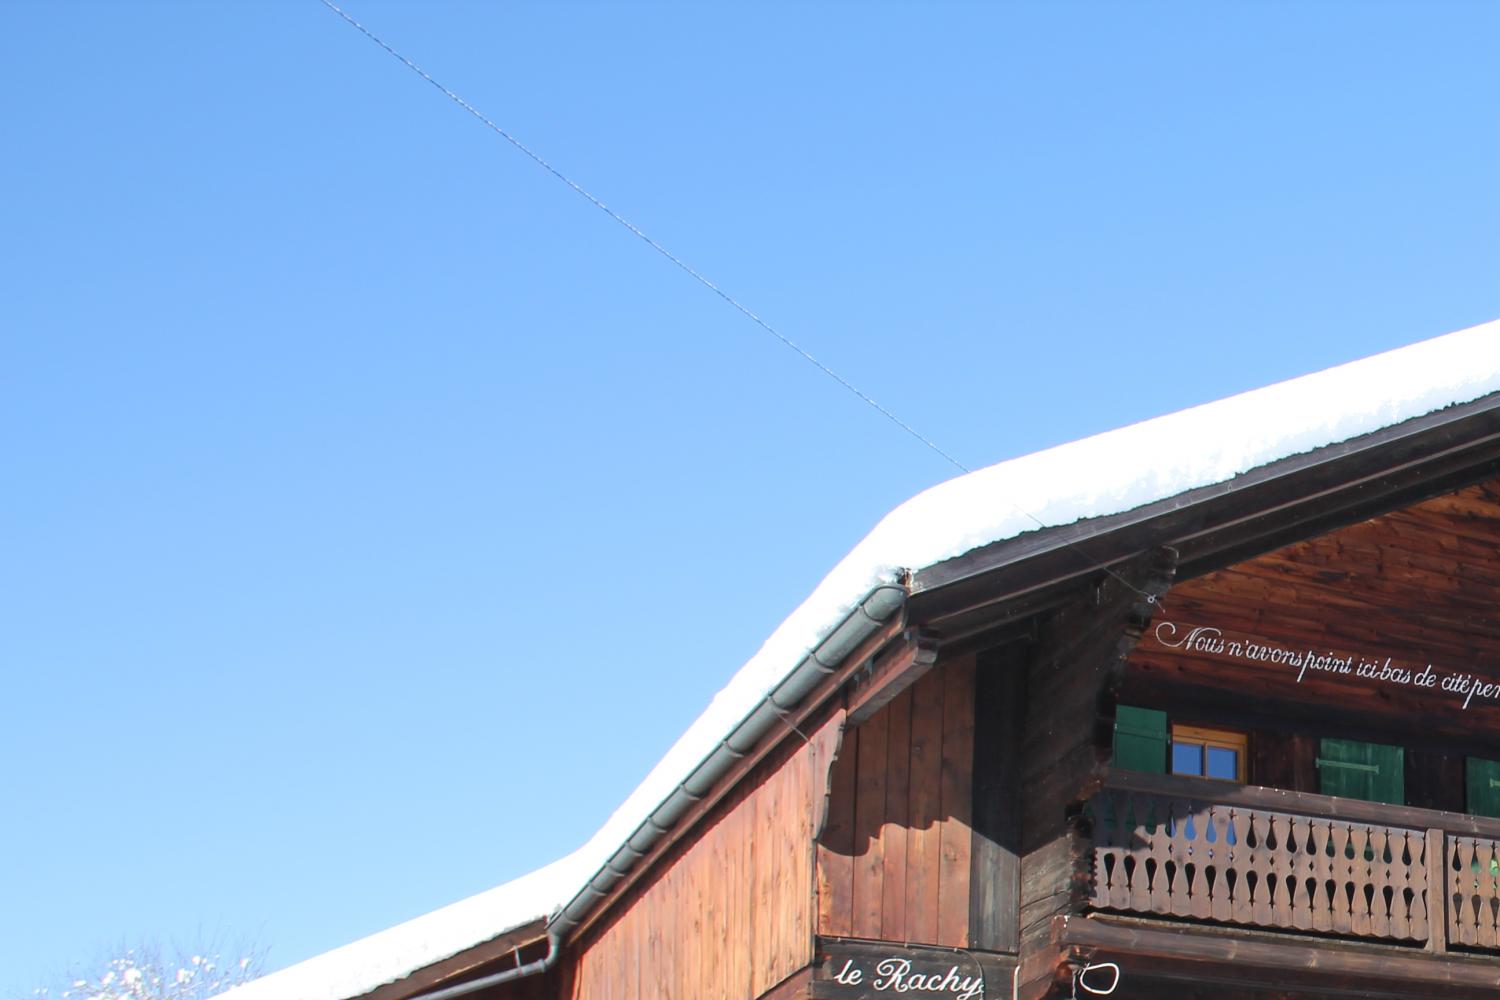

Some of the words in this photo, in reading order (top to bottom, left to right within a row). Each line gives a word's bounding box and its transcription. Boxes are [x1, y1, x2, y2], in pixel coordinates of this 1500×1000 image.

[1156, 622, 1224, 652] Nous
[1229, 640, 1302, 667] n'avons
[1296, 651, 1352, 682] point
[1414, 664, 1437, 687] de
[1441, 672, 1471, 694] cité
[834, 960, 863, 986] le
